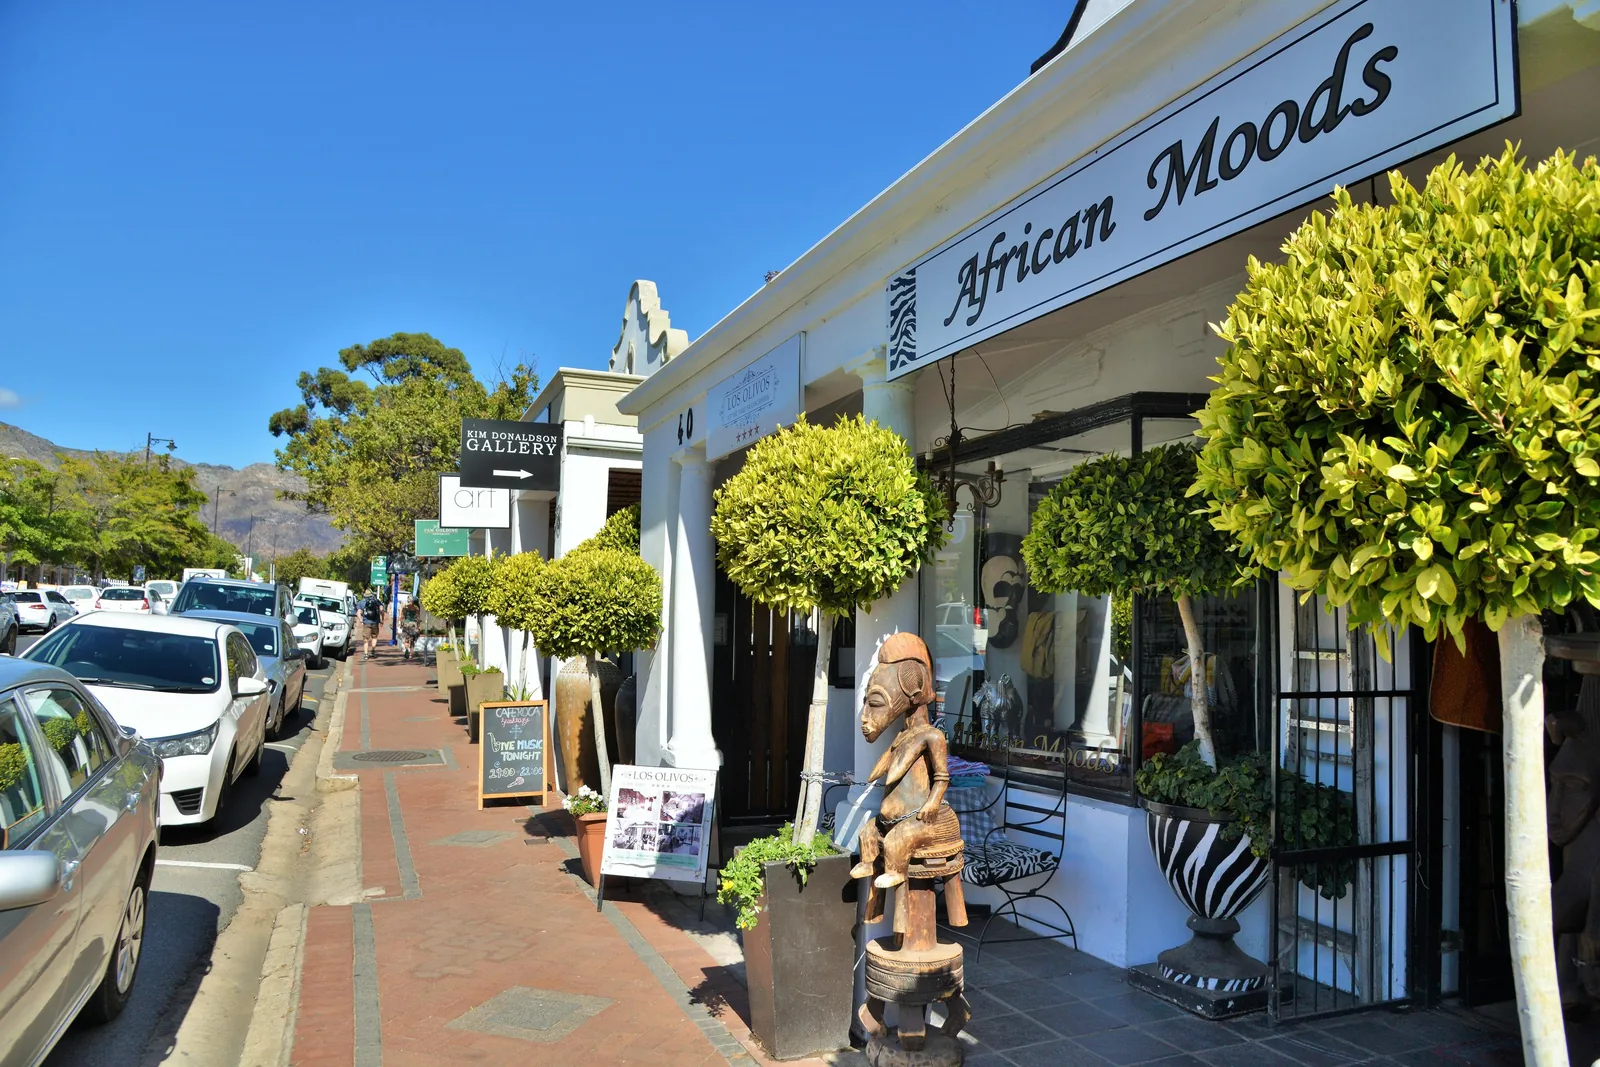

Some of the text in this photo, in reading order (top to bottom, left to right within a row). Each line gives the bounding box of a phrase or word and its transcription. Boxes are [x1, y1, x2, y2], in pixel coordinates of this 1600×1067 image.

[944, 22, 1399, 327] African Moods
[727, 393, 741, 411] LOS
[742, 375, 770, 403] OLIVOS
[678, 407, 693, 446] 40
[467, 430, 558, 443] KIM DONALDSON
[466, 438, 557, 456] GALLERY
[454, 488, 497, 508] art
[517, 739, 543, 750] MUSIC
[950, 719, 1118, 774] African Moods
[501, 751, 541, 761] TONIGHT
[633, 771, 694, 783] LOS OLIVOS
